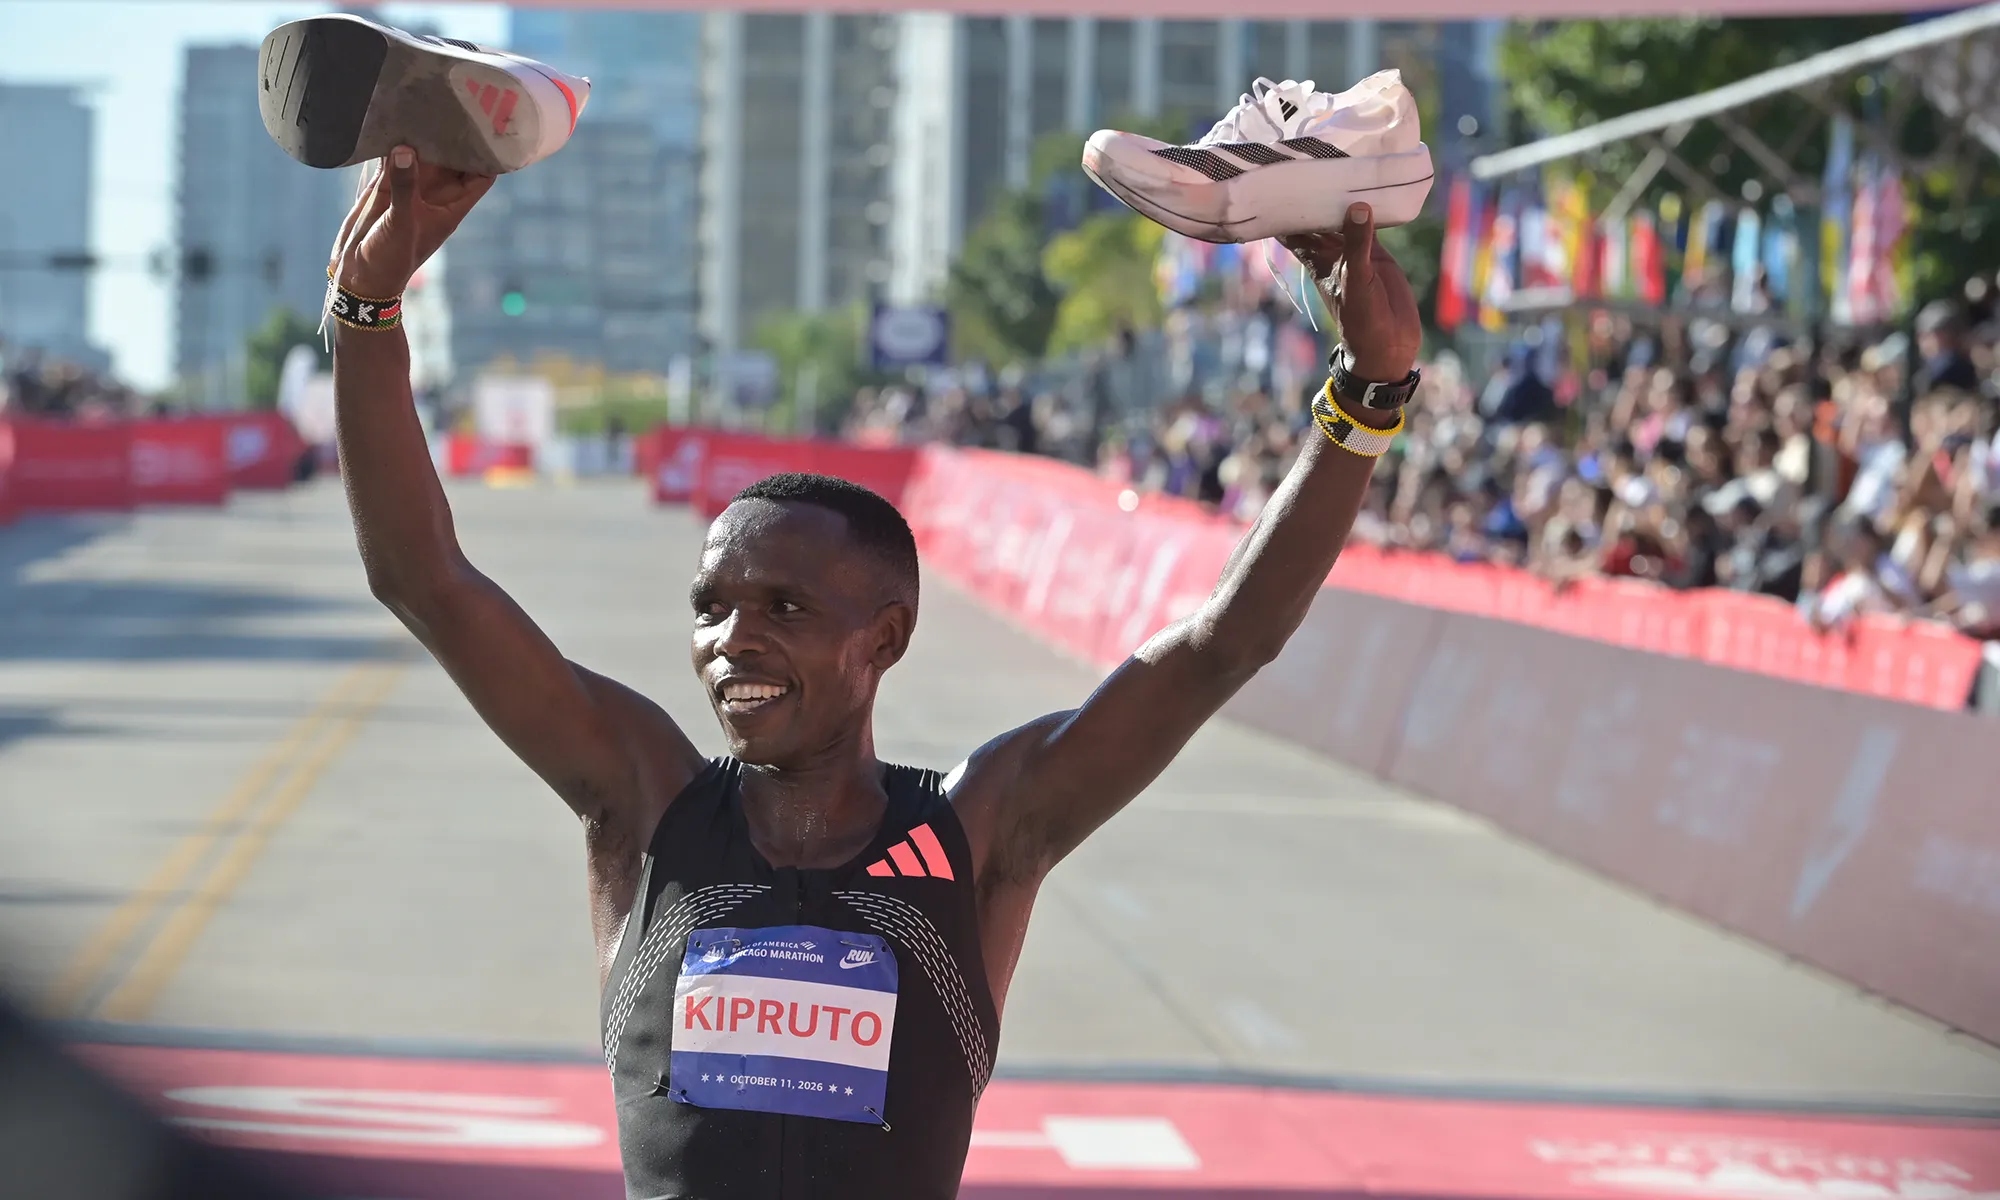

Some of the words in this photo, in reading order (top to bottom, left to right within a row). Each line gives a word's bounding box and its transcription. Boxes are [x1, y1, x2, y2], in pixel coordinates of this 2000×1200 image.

[763, 941, 799, 949] AMERICA
[769, 949, 824, 964] MARATHON
[847, 949, 875, 963] RUN
[684, 995, 882, 1047] KIPRUTO
[730, 1074, 777, 1087] OCTOBER
[780, 1079, 796, 1090] 11,
[798, 1080, 823, 1092] 2026
